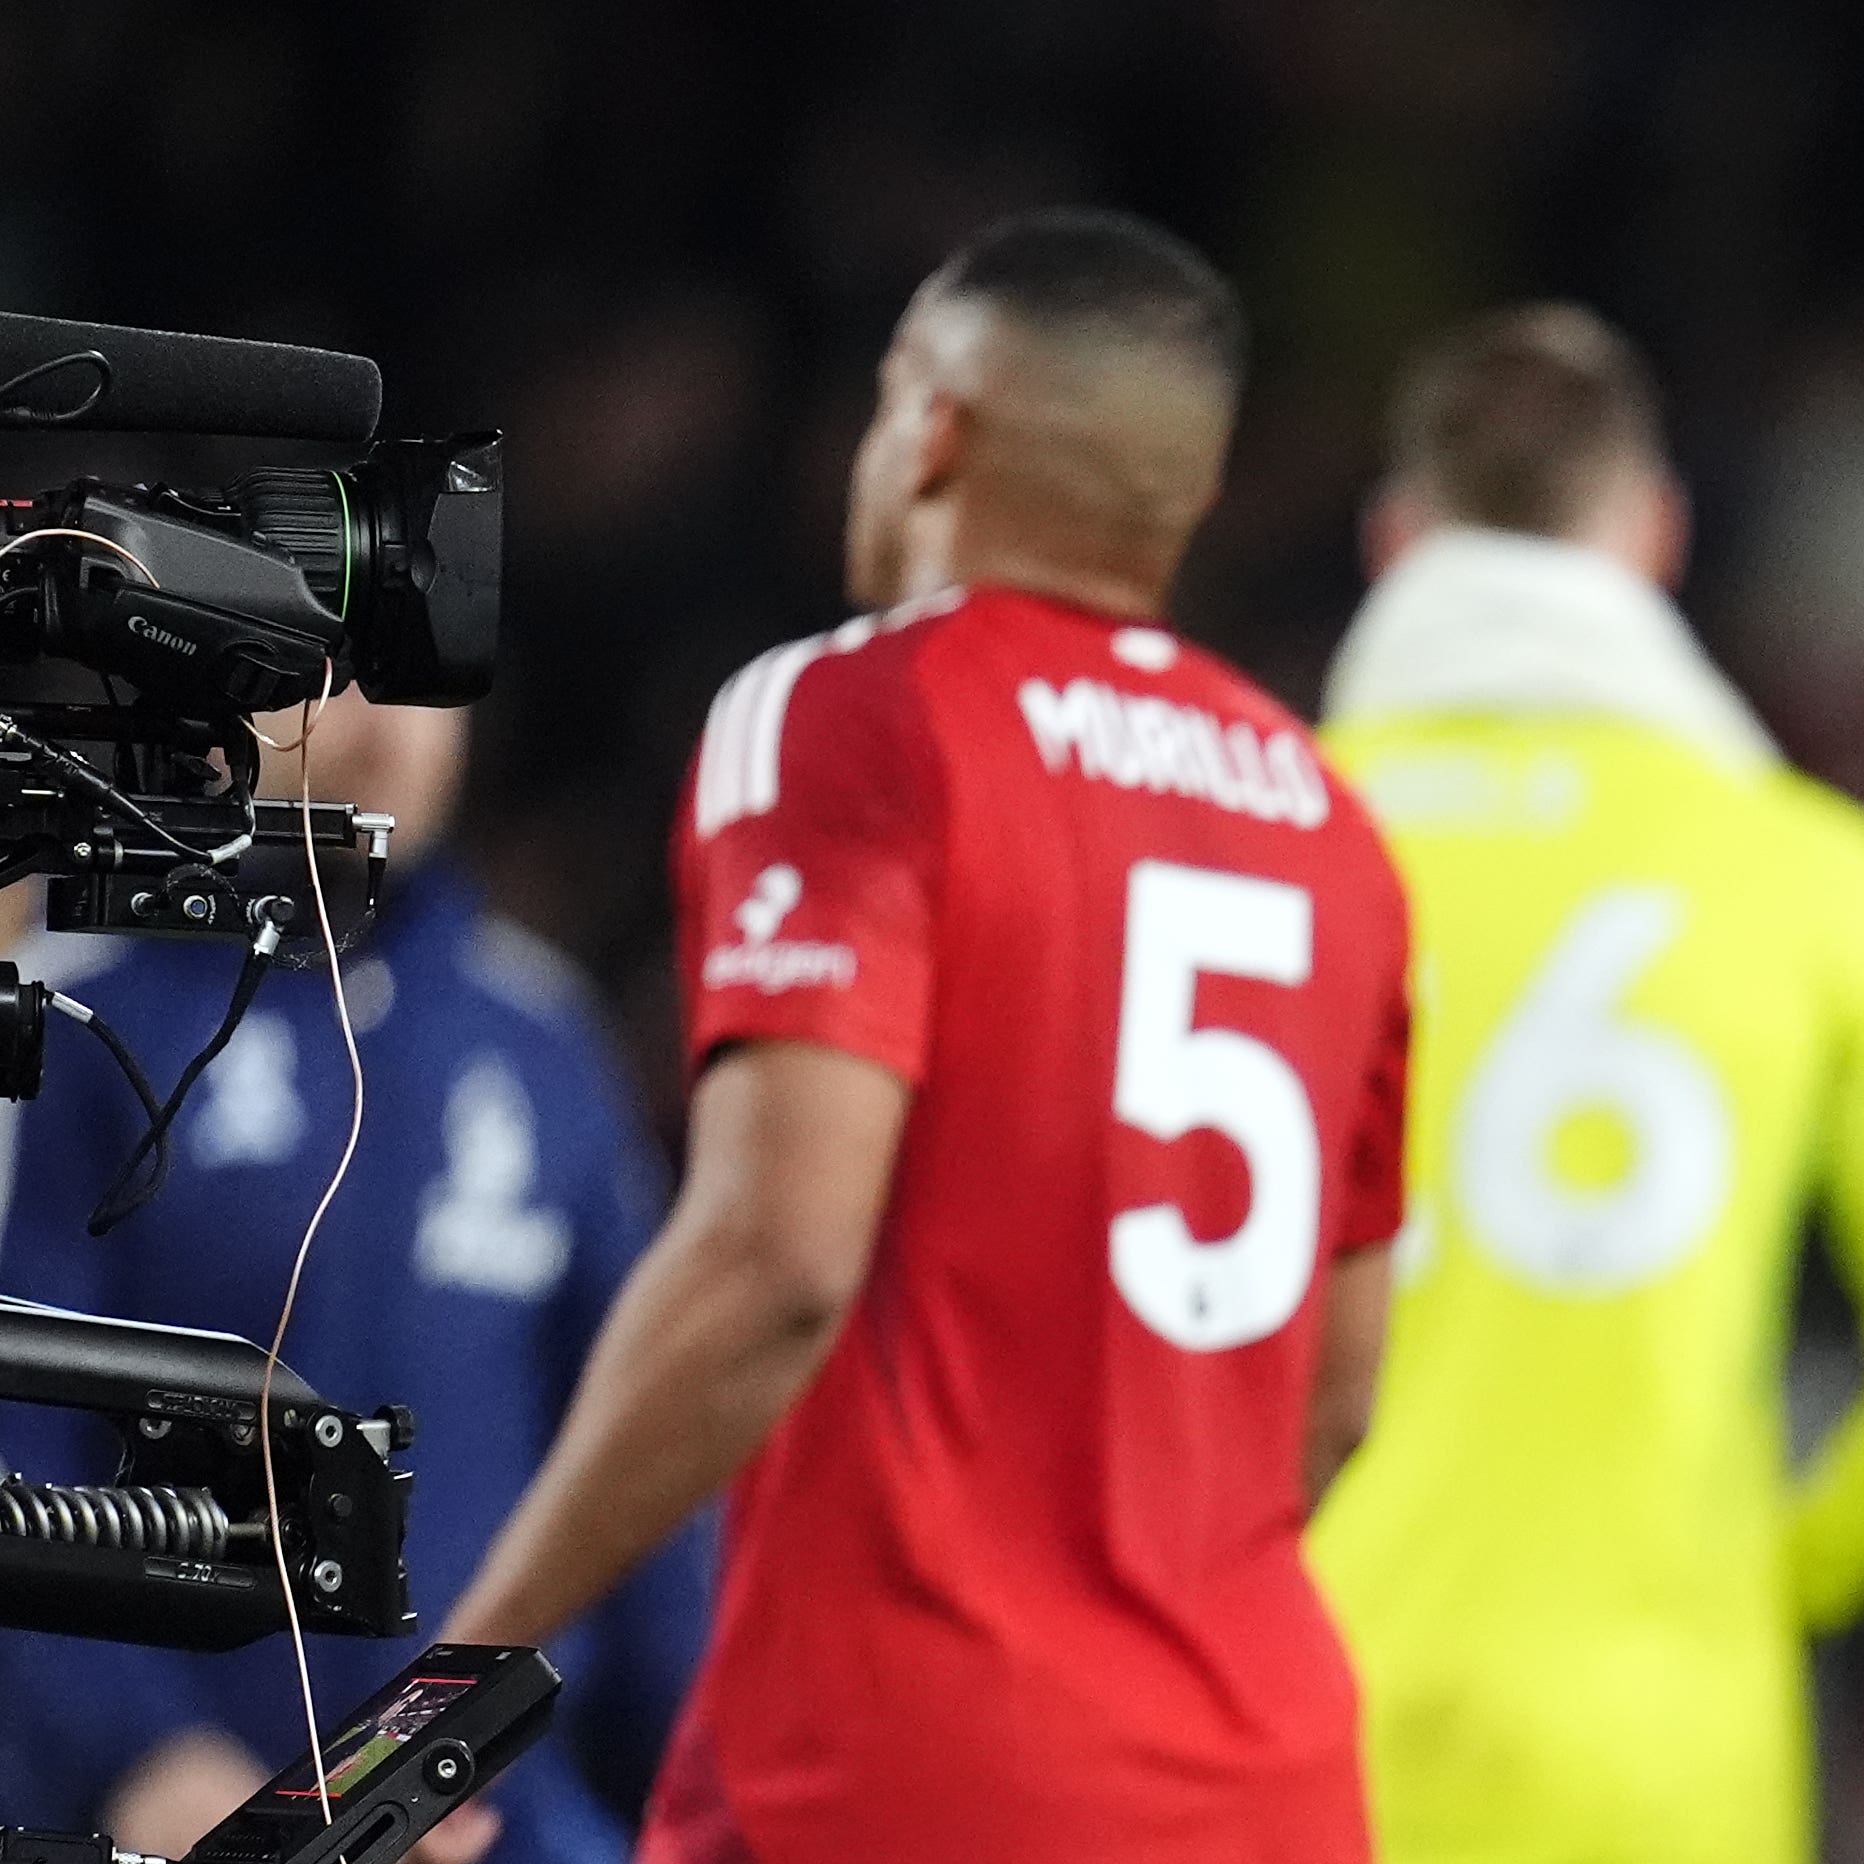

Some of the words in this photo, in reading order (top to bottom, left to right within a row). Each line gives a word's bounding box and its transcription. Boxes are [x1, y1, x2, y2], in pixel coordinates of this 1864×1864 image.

[127, 616, 197, 656] Canon
[1017, 677, 1331, 830] MURILLO
[1109, 858, 1322, 1352] 5
[1400, 880, 1737, 1300] 6
